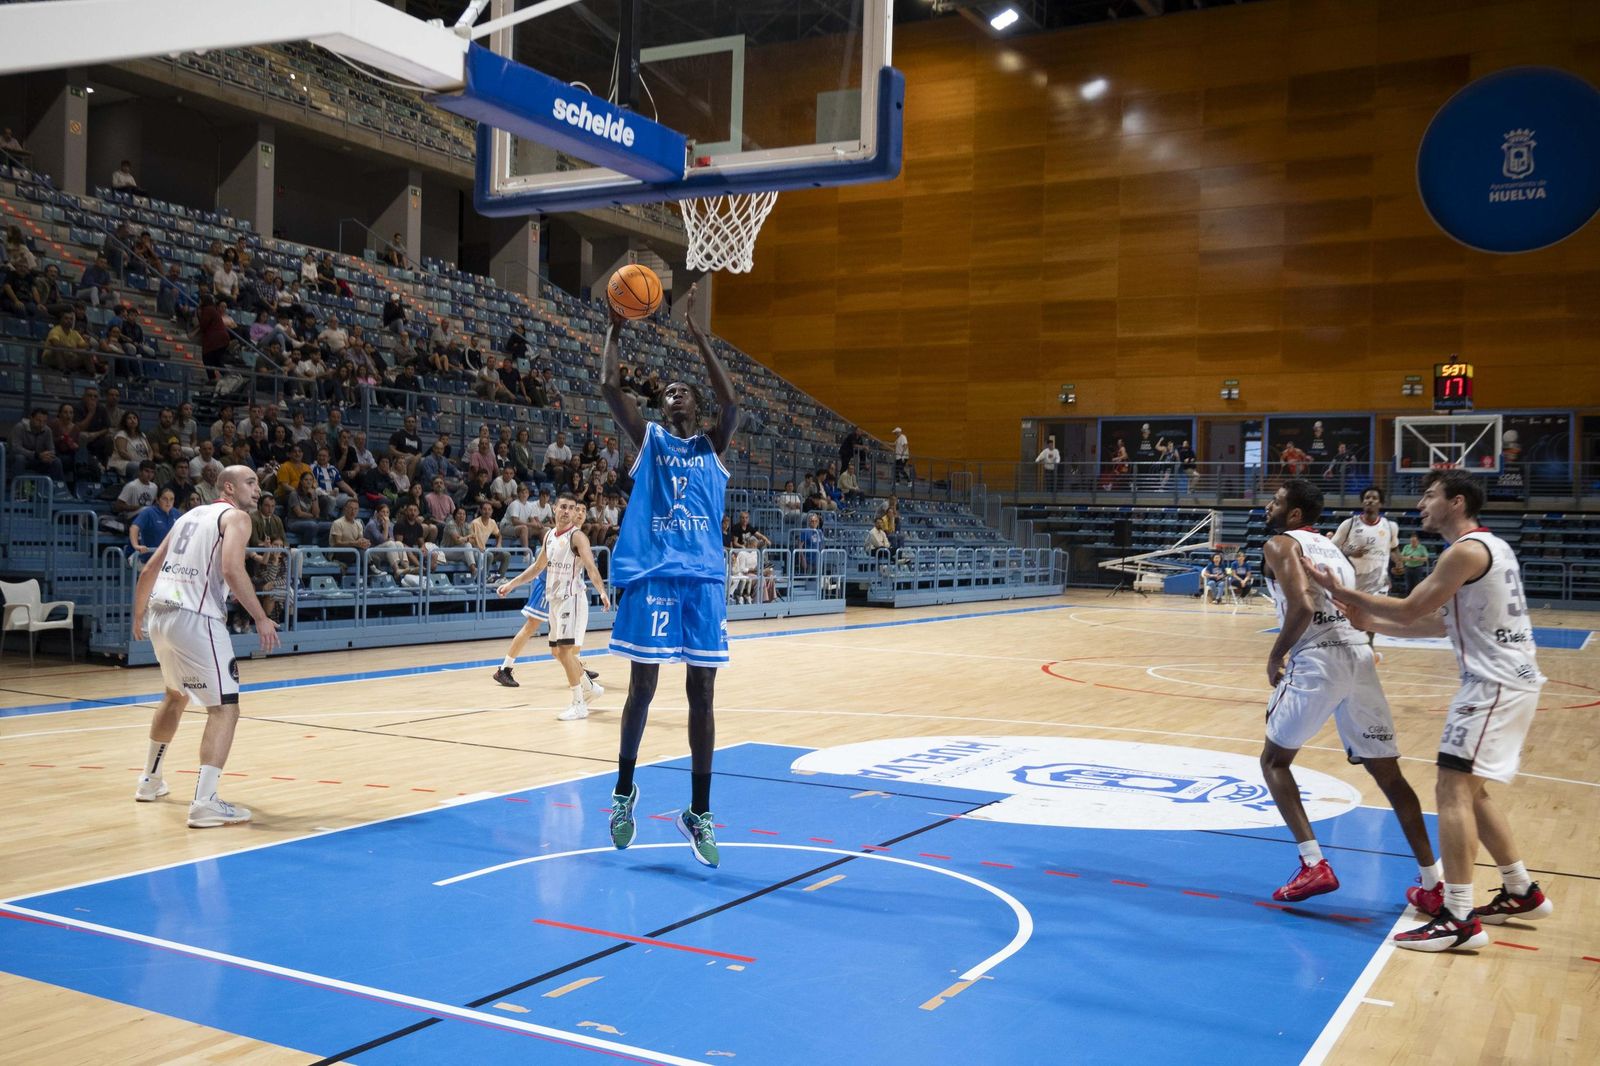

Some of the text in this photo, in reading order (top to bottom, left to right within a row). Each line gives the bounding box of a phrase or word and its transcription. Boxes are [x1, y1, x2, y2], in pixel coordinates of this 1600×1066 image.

[553, 97, 635, 147] schelde
[1488, 187, 1546, 202] HUELVA
[1444, 377, 1464, 396] 17
[671, 475, 688, 499] 12
[652, 519, 709, 532] EMERITA
[173, 521, 200, 555] 8
[561, 624, 568, 635] 7
[651, 610, 670, 637] 12
[1441, 723, 1468, 747] 33
[855, 740, 1001, 779] HUELVA
